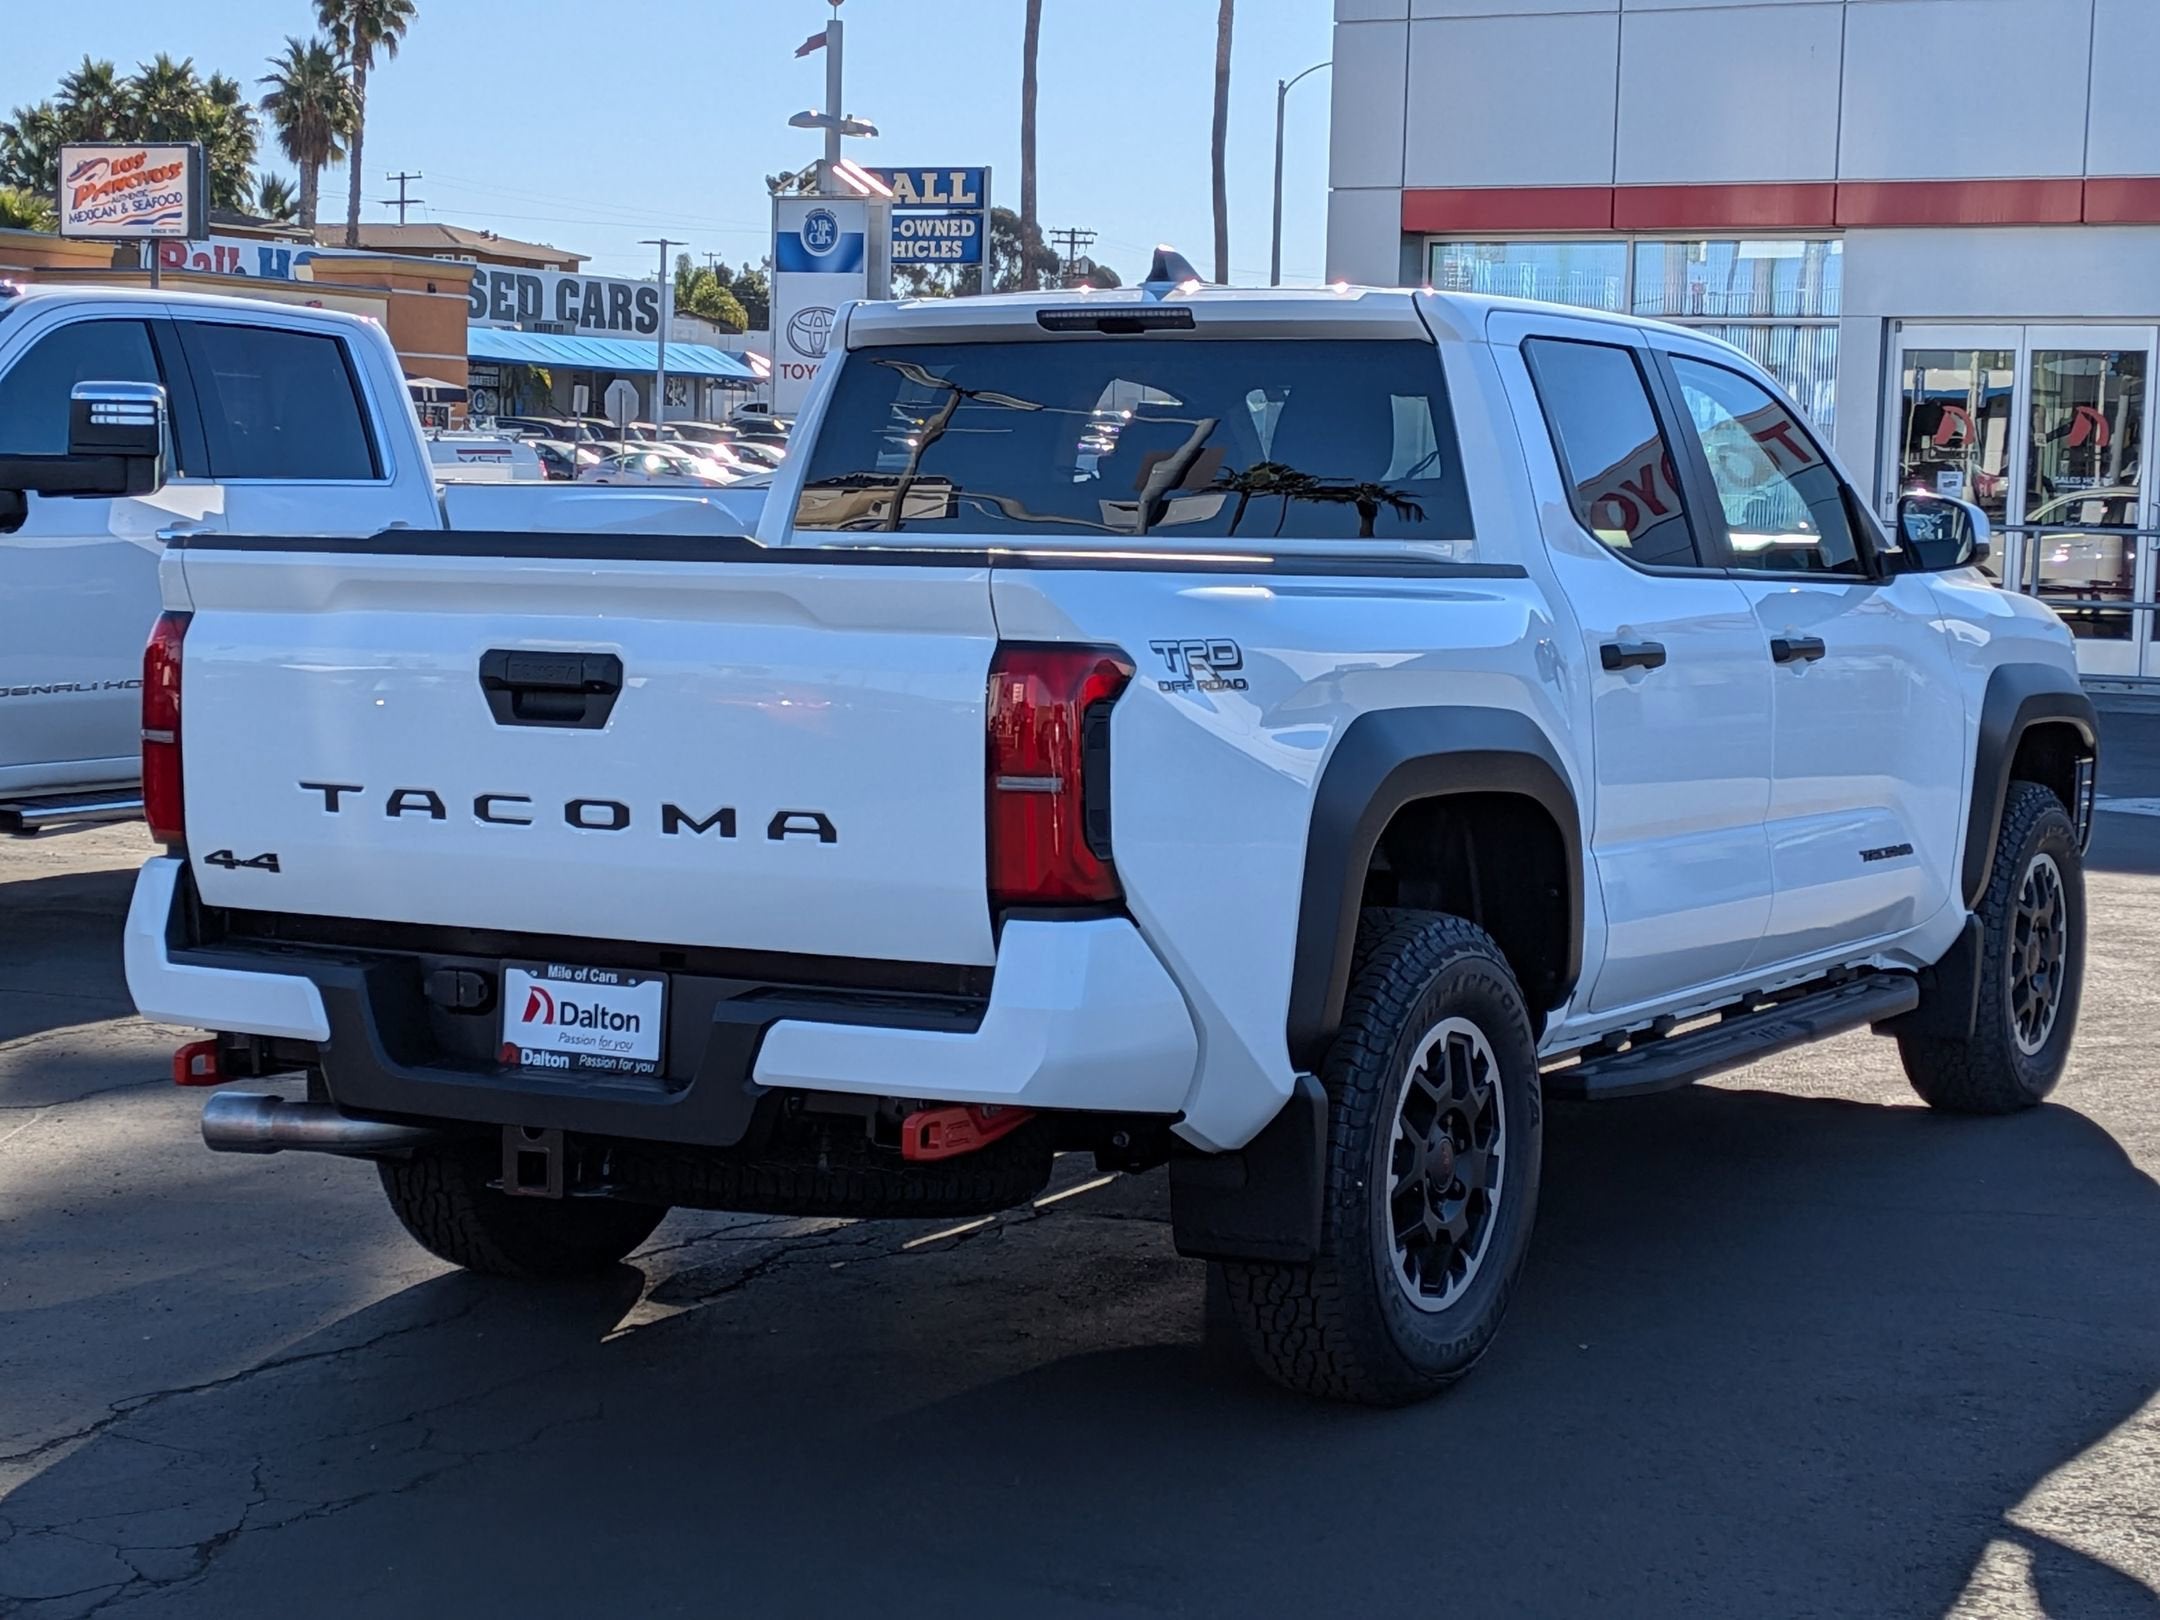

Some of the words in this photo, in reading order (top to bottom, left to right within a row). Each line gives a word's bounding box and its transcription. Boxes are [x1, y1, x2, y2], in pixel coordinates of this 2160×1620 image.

[873, 172, 976, 204] ALL
[68, 205, 117, 225] MEXICAN
[121, 202, 128, 214] &
[132, 191, 183, 212] SEAFOOD
[556, 278, 659, 334] CARS
[780, 363, 821, 380] TOY
[1148, 638, 1244, 681] TRD
[1158, 680, 1195, 694] OFF
[1196, 678, 1249, 693] ROAD
[298, 782, 838, 843] TACOMA
[547, 964, 572, 979] Mile
[574, 968, 589, 981] of
[590, 968, 618, 984] Cars
[559, 1001, 640, 1033] Dalton
[558, 1032, 597, 1046] Passion
[598, 1035, 613, 1048] for
[613, 1040, 634, 1050] you
[520, 1048, 570, 1069] Dalton
[578, 1053, 617, 1069] Passion
[617, 1058, 634, 1070] for
[634, 1062, 655, 1074] you
